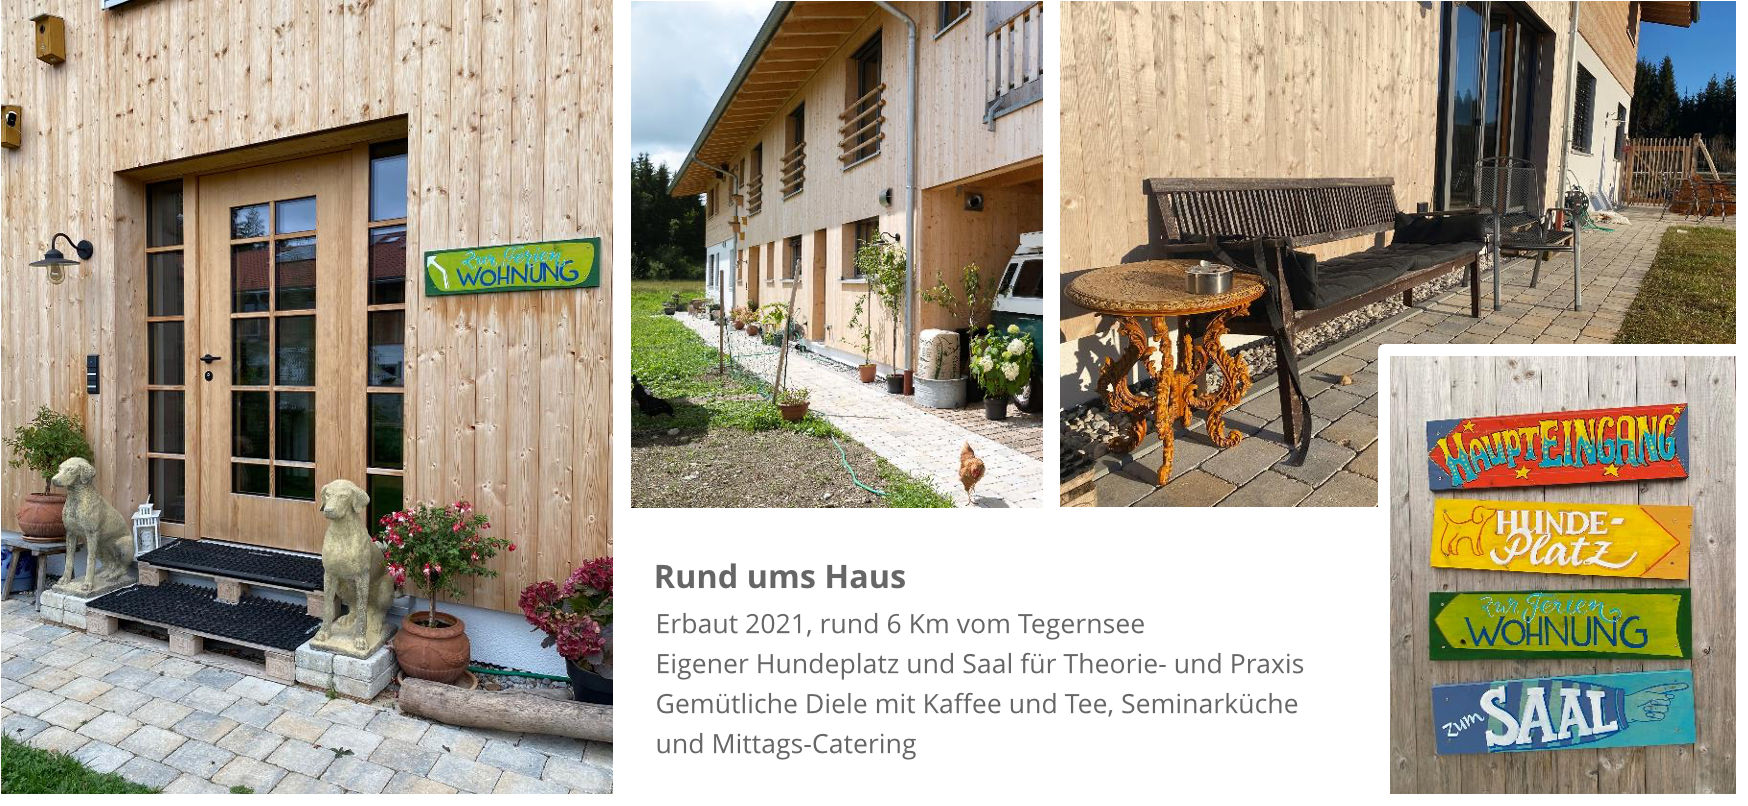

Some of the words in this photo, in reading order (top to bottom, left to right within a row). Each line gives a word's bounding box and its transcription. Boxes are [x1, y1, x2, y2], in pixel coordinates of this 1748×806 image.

[456, 259, 579, 287] WOHNUNG
[462, 249, 497, 270] Zur
[502, 246, 567, 268] Ferien
[1436, 414, 1676, 487] HAUPTEINGANG
[1496, 510, 1624, 536] HUNDE-
[1490, 530, 1638, 568] Platz
[1480, 595, 1519, 618] Zur
[1521, 592, 1623, 623] Ferien
[1464, 616, 1648, 648] WOHNUNG
[1442, 711, 1486, 738] zum
[1479, 686, 1618, 747] SAAL
